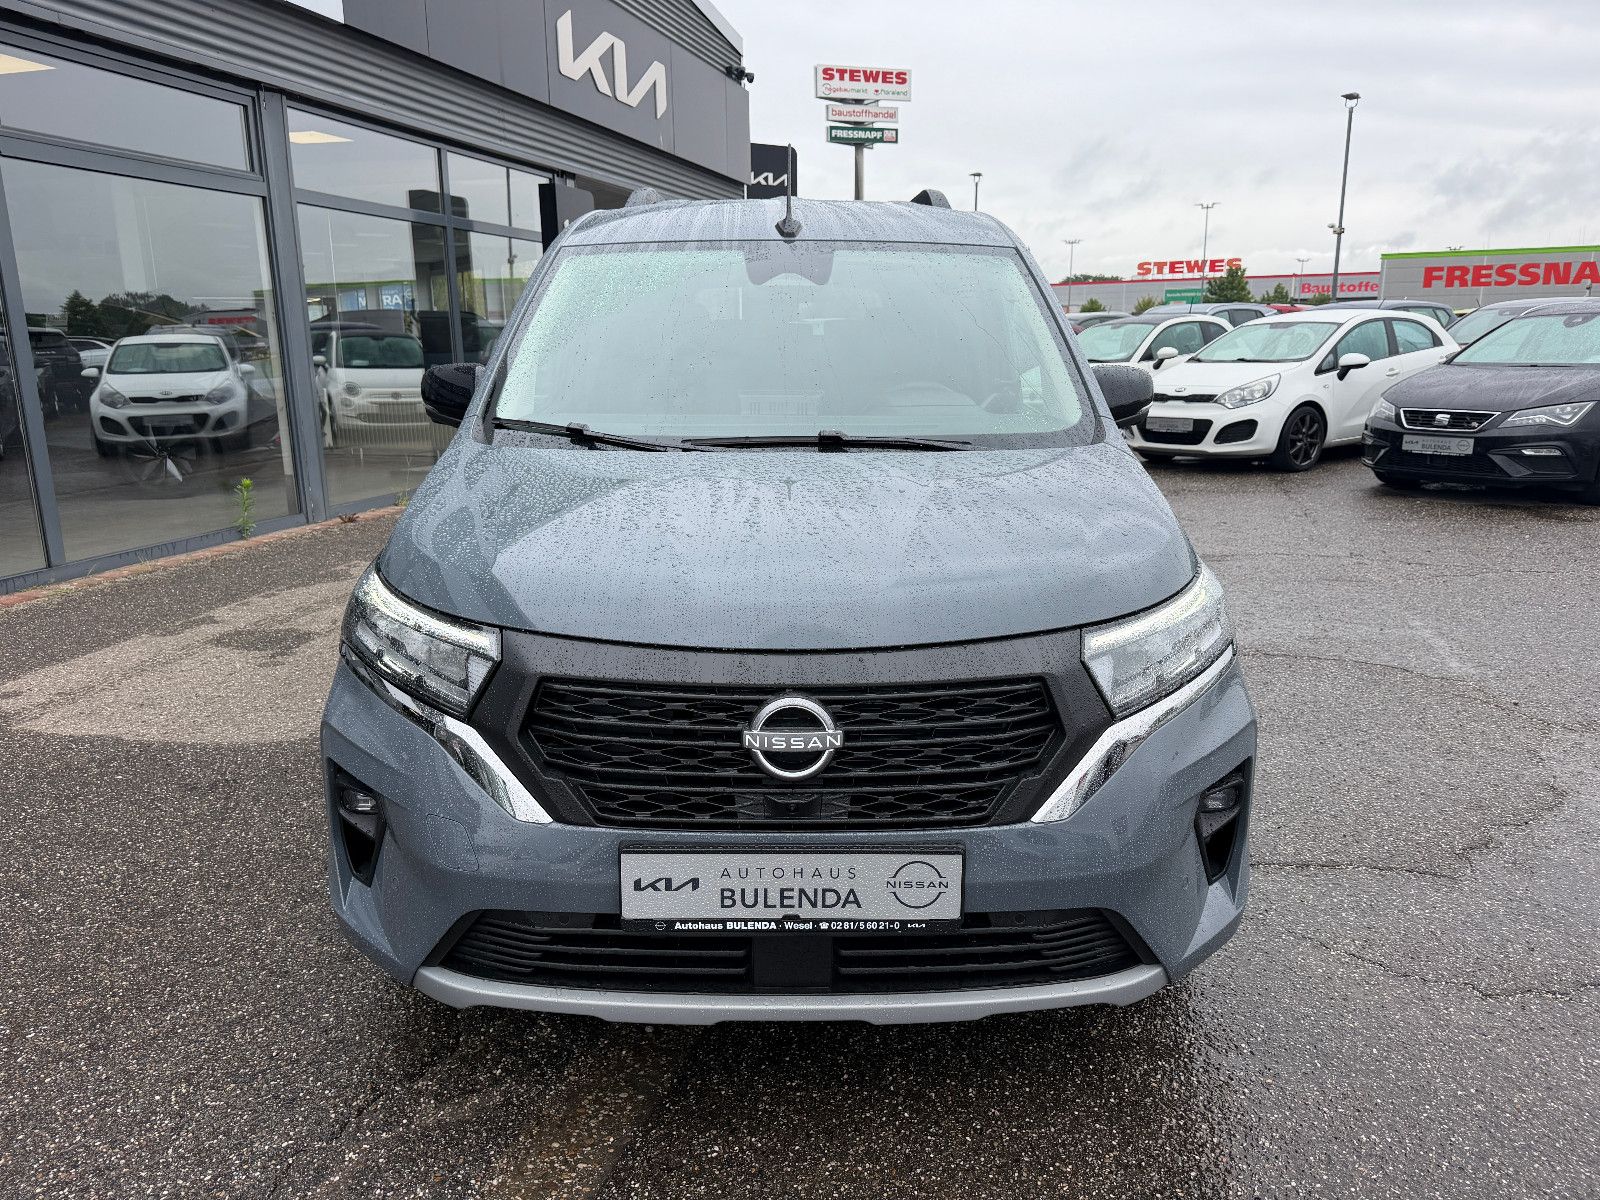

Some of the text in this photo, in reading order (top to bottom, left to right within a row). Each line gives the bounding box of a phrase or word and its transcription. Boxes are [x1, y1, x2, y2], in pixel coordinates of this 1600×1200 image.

[556, 9, 668, 120] KIA
[821, 67, 908, 85] STEWES
[831, 108, 897, 119] baustoffhandel
[831, 129, 883, 139] FRESSNAPF
[751, 171, 788, 187] KIA
[1136, 258, 1242, 276] STEWES
[1422, 261, 1600, 289] FRESSNA
[1301, 281, 1379, 293] Bautoffe
[745, 734, 841, 749] NISSAN
[720, 867, 857, 879] AUTOHAUS
[633, 877, 700, 892] KIA
[886, 880, 949, 889] NISSAN
[720, 887, 863, 909] BULENDA
[674, 921, 723, 930] Autohaus
[726, 921, 777, 930] BULENDA
[784, 921, 813, 930] Wesel
